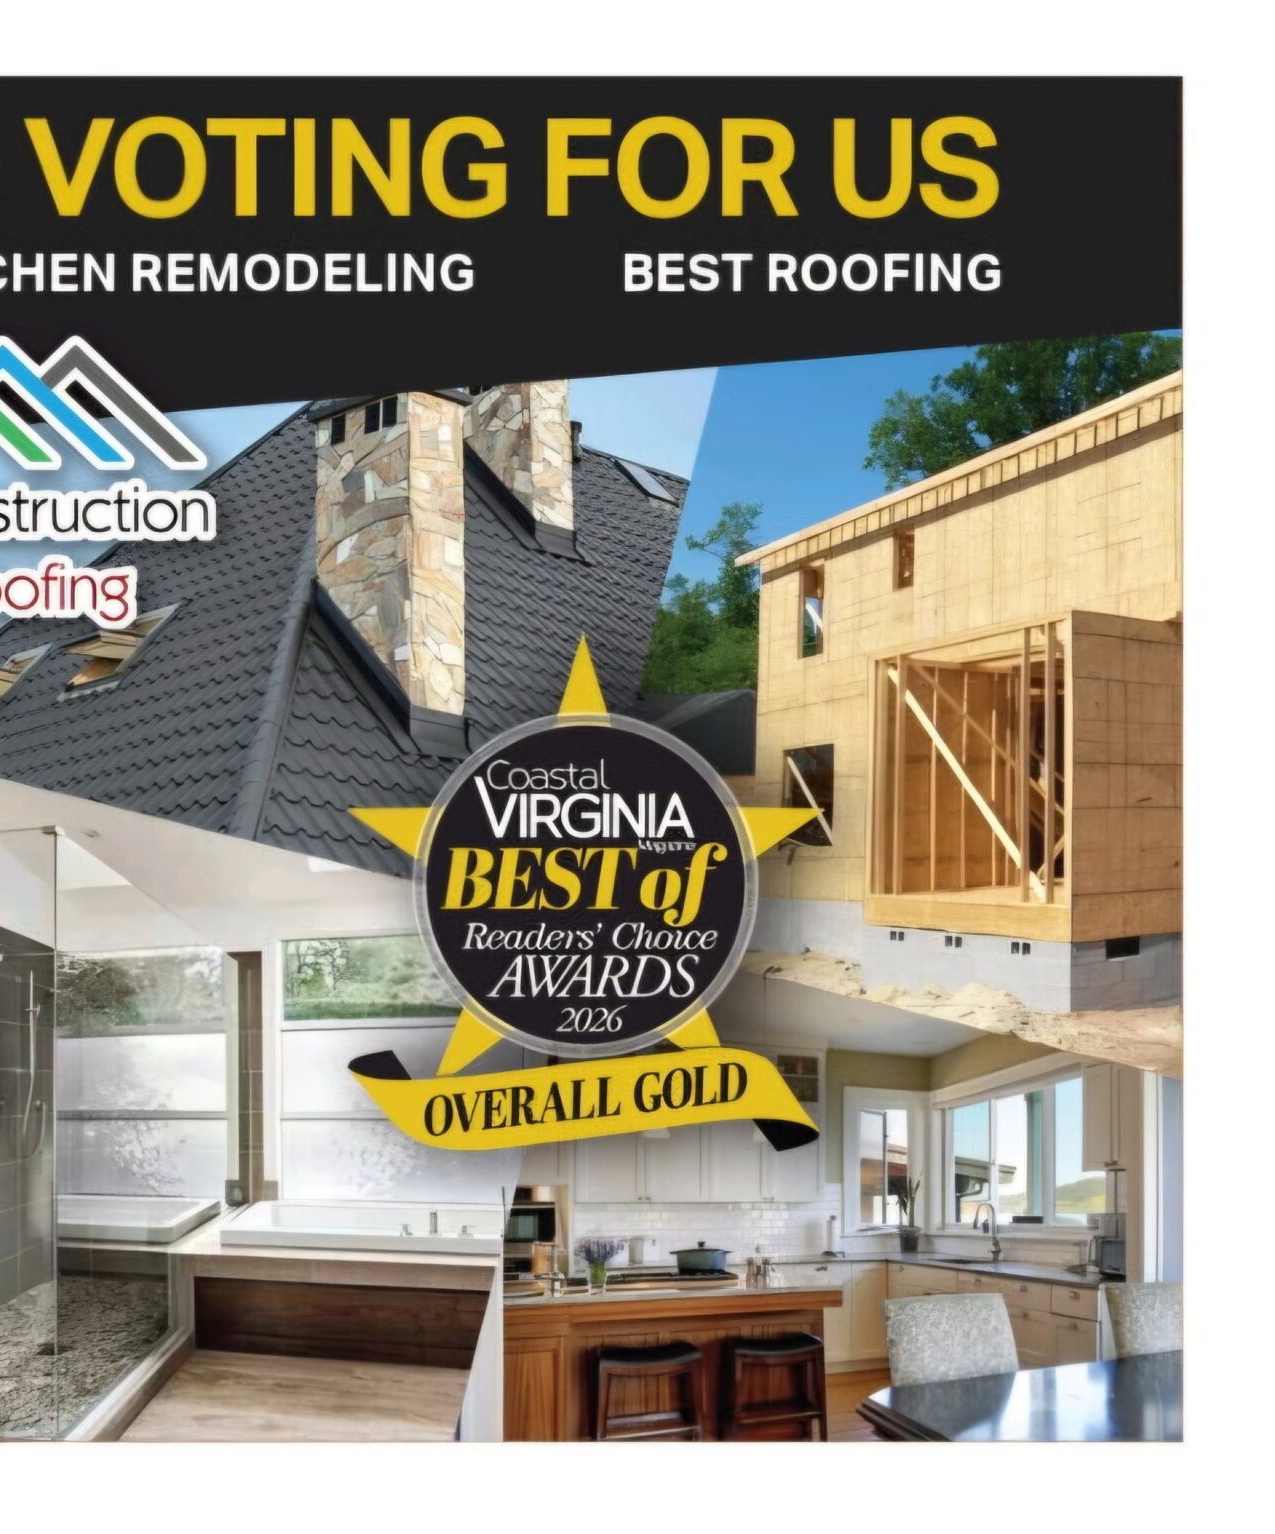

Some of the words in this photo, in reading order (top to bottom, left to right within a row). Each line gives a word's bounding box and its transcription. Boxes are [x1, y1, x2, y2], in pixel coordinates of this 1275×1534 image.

[24, 116, 507, 219] VOTING
[547, 116, 798, 219] FOR
[834, 116, 1000, 219] US
[132, 253, 474, 292] REMODELING
[625, 253, 753, 292] BEST
[769, 253, 1001, 292] ROOFING
[486, 759, 610, 791] Coastal
[474, 776, 695, 838] VIRGINIA
[440, 847, 637, 910] BEST
[639, 842, 728, 928] of
[463, 922, 603, 950] Readers'
[612, 922, 718, 950] Choice
[486, 955, 699, 998] AWARDS
[556, 1005, 628, 1033] 2026
[423, 1076, 621, 1137] OVERALL
[633, 1062, 749, 1115] GOLD
